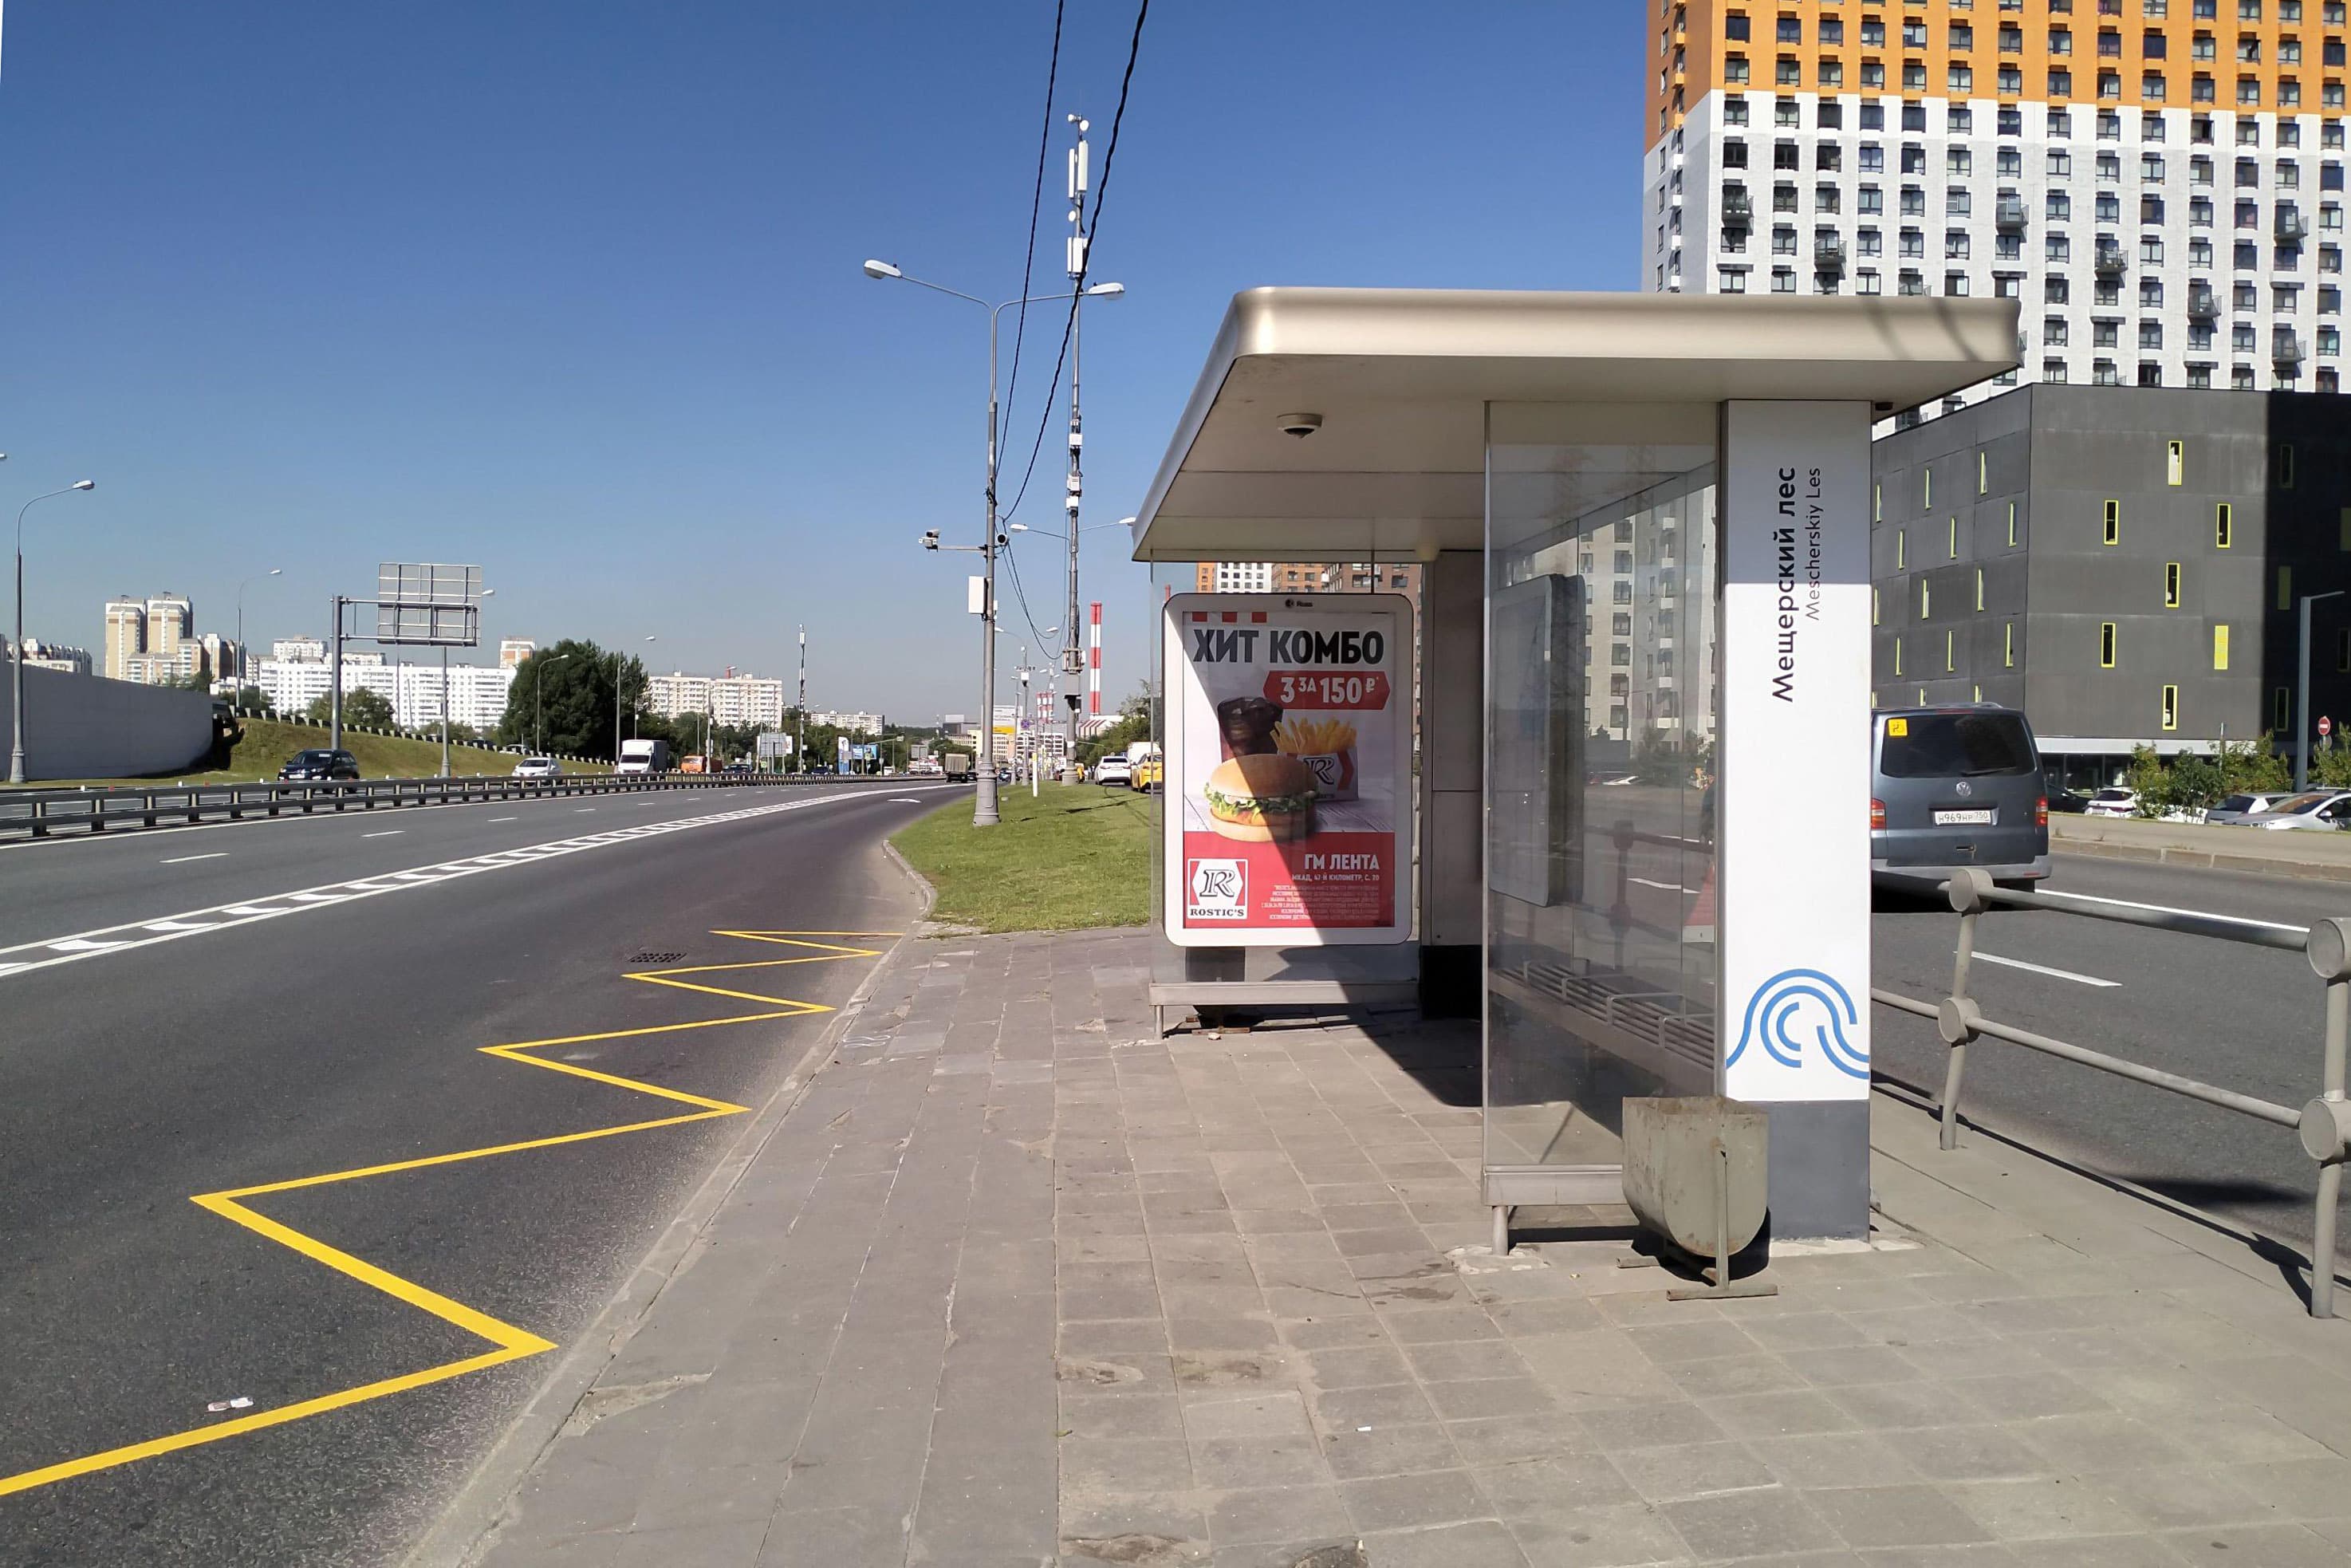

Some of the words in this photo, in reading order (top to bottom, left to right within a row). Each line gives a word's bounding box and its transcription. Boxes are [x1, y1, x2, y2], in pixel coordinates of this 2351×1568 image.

[1778, 467, 1796, 517] лес
[1806, 467, 1821, 498] Les
[1805, 504, 1824, 621] Mescherskiy
[1772, 527, 1799, 703] Мещерский
[1193, 629, 1260, 664] ХИТ
[1270, 630, 1385, 665] КОМБО
[1304, 853, 1325, 869] ГМ
[1329, 853, 1380, 869] ЛЕНТА
[1199, 869, 1235, 898] R
[1190, 908, 1245, 917] ROSTIC'S
